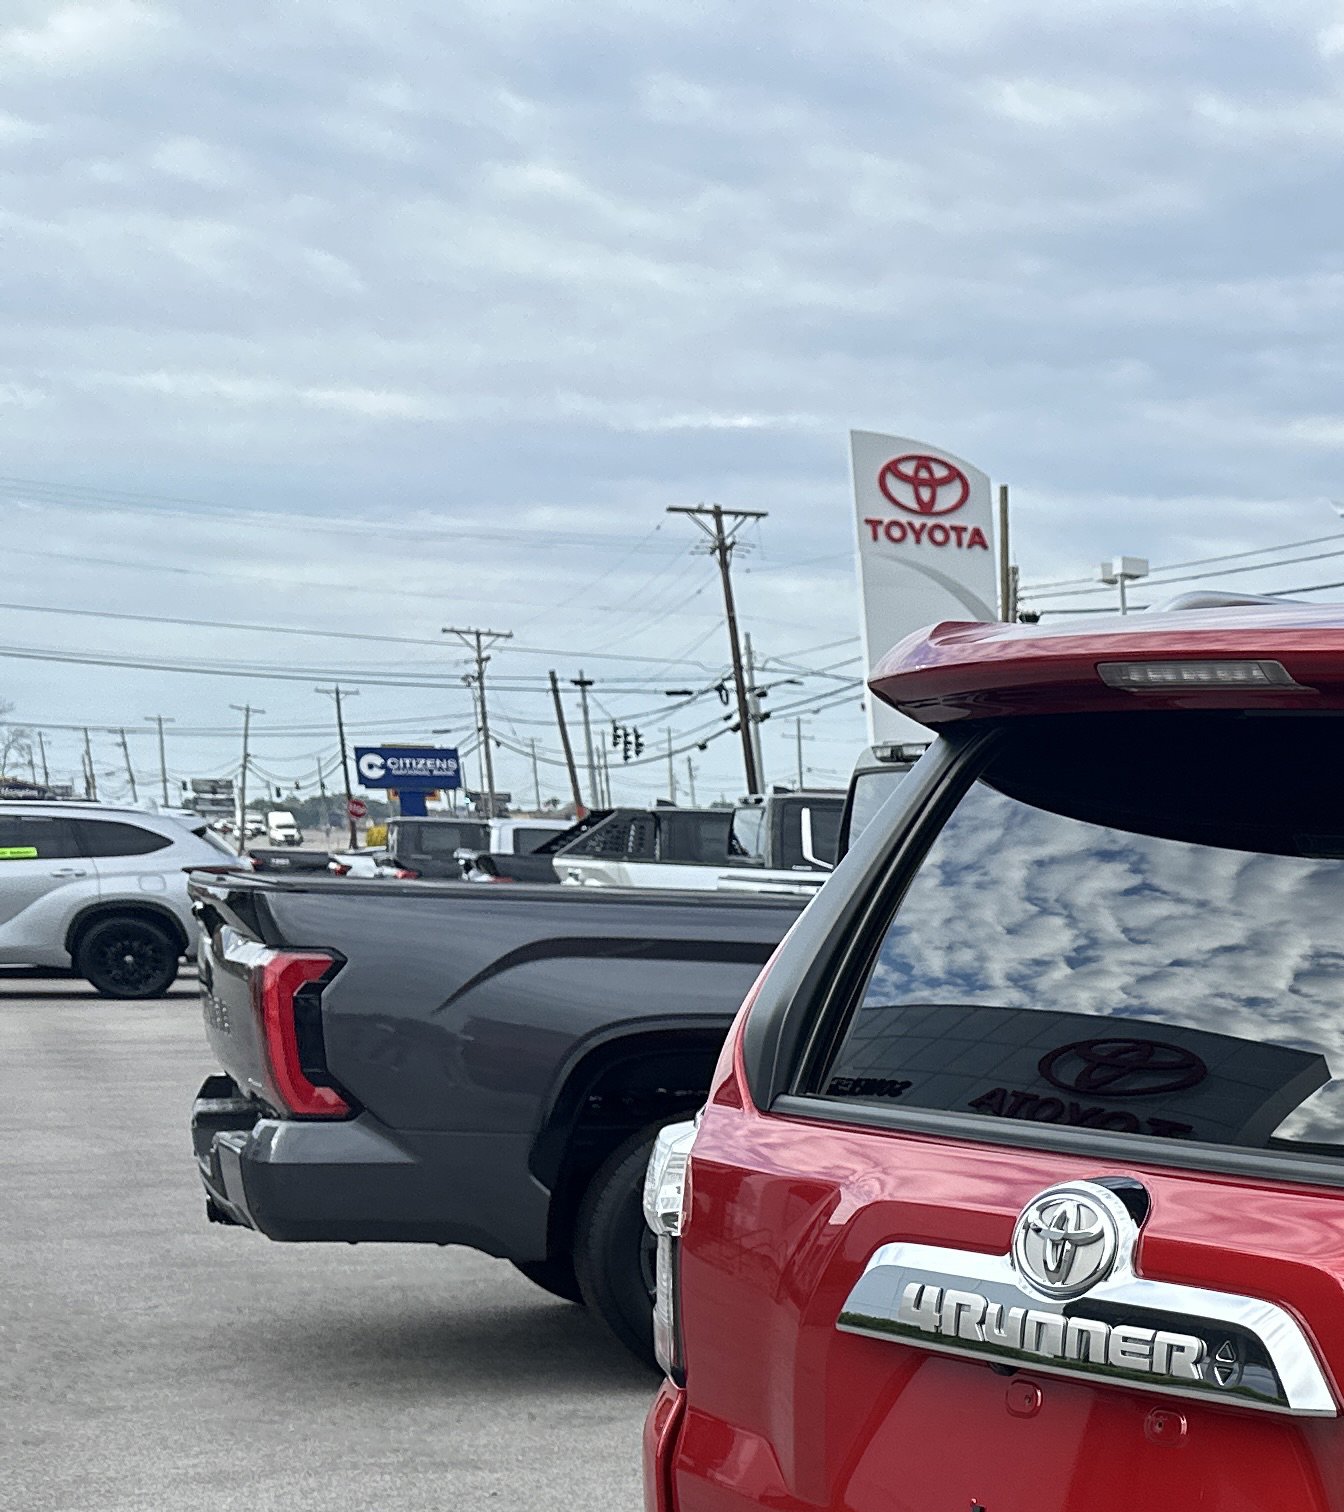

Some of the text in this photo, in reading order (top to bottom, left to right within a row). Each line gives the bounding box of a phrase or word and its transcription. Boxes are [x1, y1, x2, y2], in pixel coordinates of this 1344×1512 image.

[864, 518, 989, 550] TOYOTA
[387, 757, 458, 770] CITIZENS
[899, 1282, 1207, 1380] 4RUNNER
